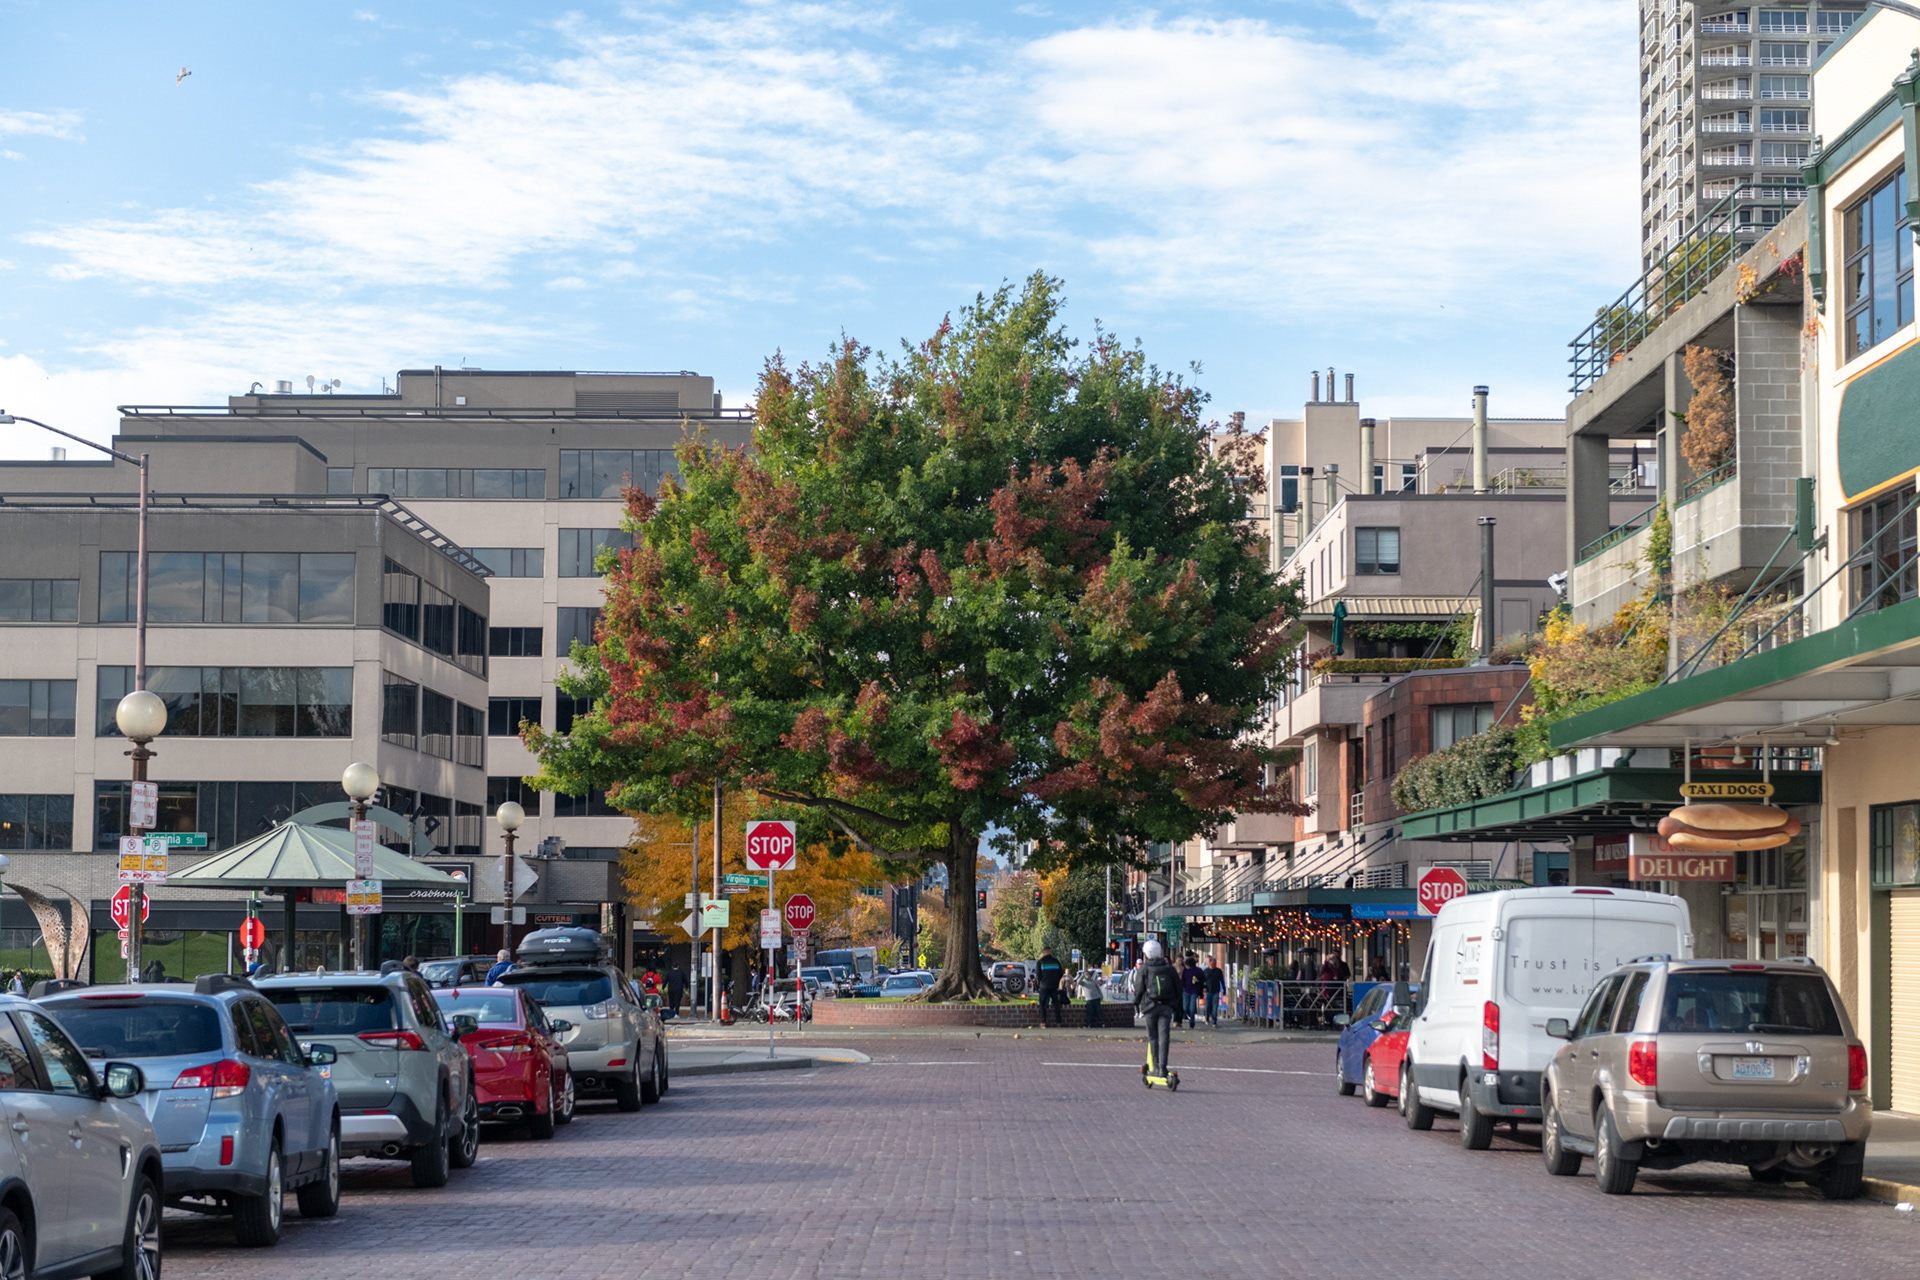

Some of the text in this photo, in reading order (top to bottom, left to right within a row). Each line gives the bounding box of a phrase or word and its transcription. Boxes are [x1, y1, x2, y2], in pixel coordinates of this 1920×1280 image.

[1688, 785, 1767, 795] TAXI DOGS
[186, 836, 193, 844] St
[750, 836, 792, 855] STOP
[1639, 857, 1728, 877] DELIGHT
[725, 874, 750, 884] Virginia
[1421, 882, 1464, 900] STOP
[1468, 883, 1492, 892] WINE
[535, 914, 572, 922] CUTTERS
[787, 905, 814, 919] STOP
[1511, 954, 1567, 969] Trust
[1583, 957, 1601, 971] is
